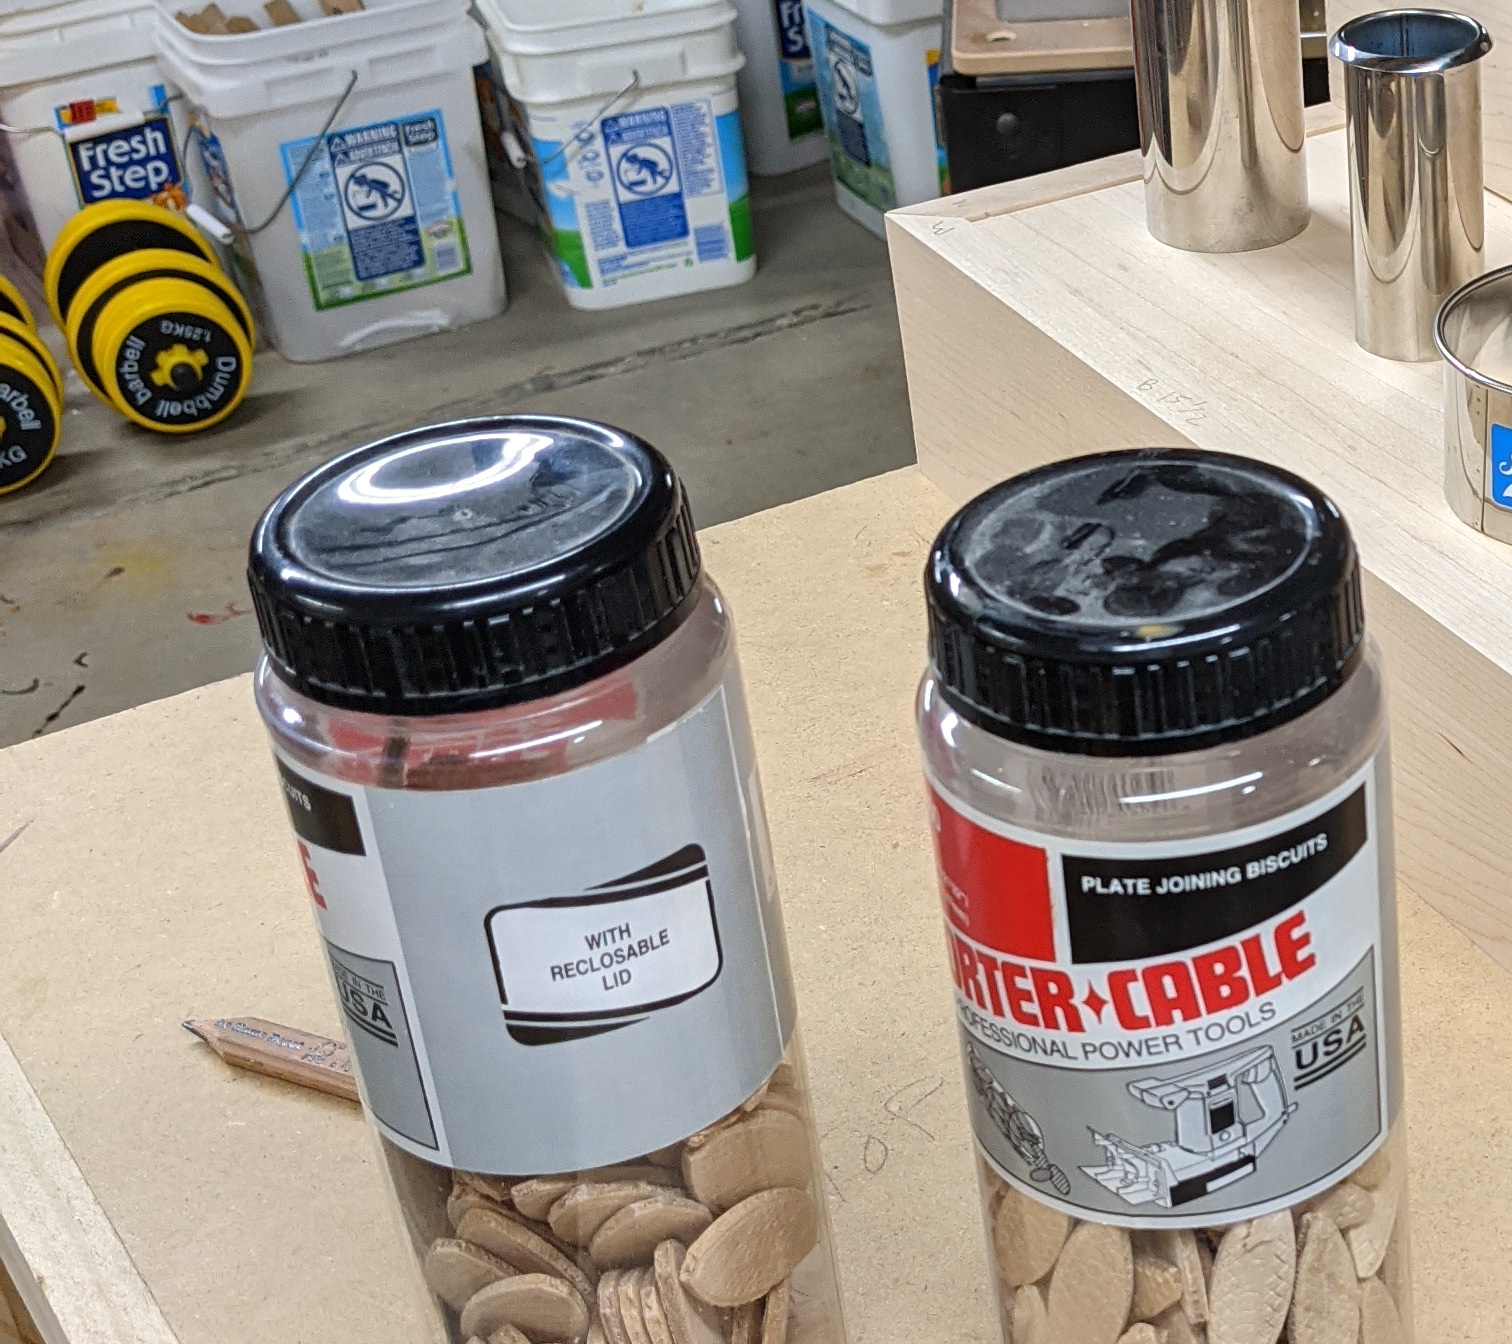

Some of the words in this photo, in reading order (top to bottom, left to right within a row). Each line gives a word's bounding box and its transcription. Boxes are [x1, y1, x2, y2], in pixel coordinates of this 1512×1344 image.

[78, 127, 167, 172] Fresh
[90, 160, 170, 198] Step
[118, 335, 153, 406] barbell
[155, 356, 237, 418] Dumbbell
[1081, 875, 1151, 895] PLATE
[1154, 865, 1243, 895] JOINING
[1245, 831, 1329, 880] BISCUITS
[550, 928, 671, 982] RECLOSABLE
[584, 922, 633, 951] WITH
[365, 983, 387, 1002] THE
[602, 968, 633, 991] LID
[952, 931, 1086, 1034] RTER
[1107, 910, 1317, 1032] CABLE
[334, 973, 394, 1030] USA
[1291, 1019, 1326, 1044] MADE
[1330, 1009, 1343, 1025] IN
[1081, 1033, 1183, 1061] POWER
[1186, 1001, 1279, 1047] TOOLS
[1295, 1013, 1365, 1070] USA
